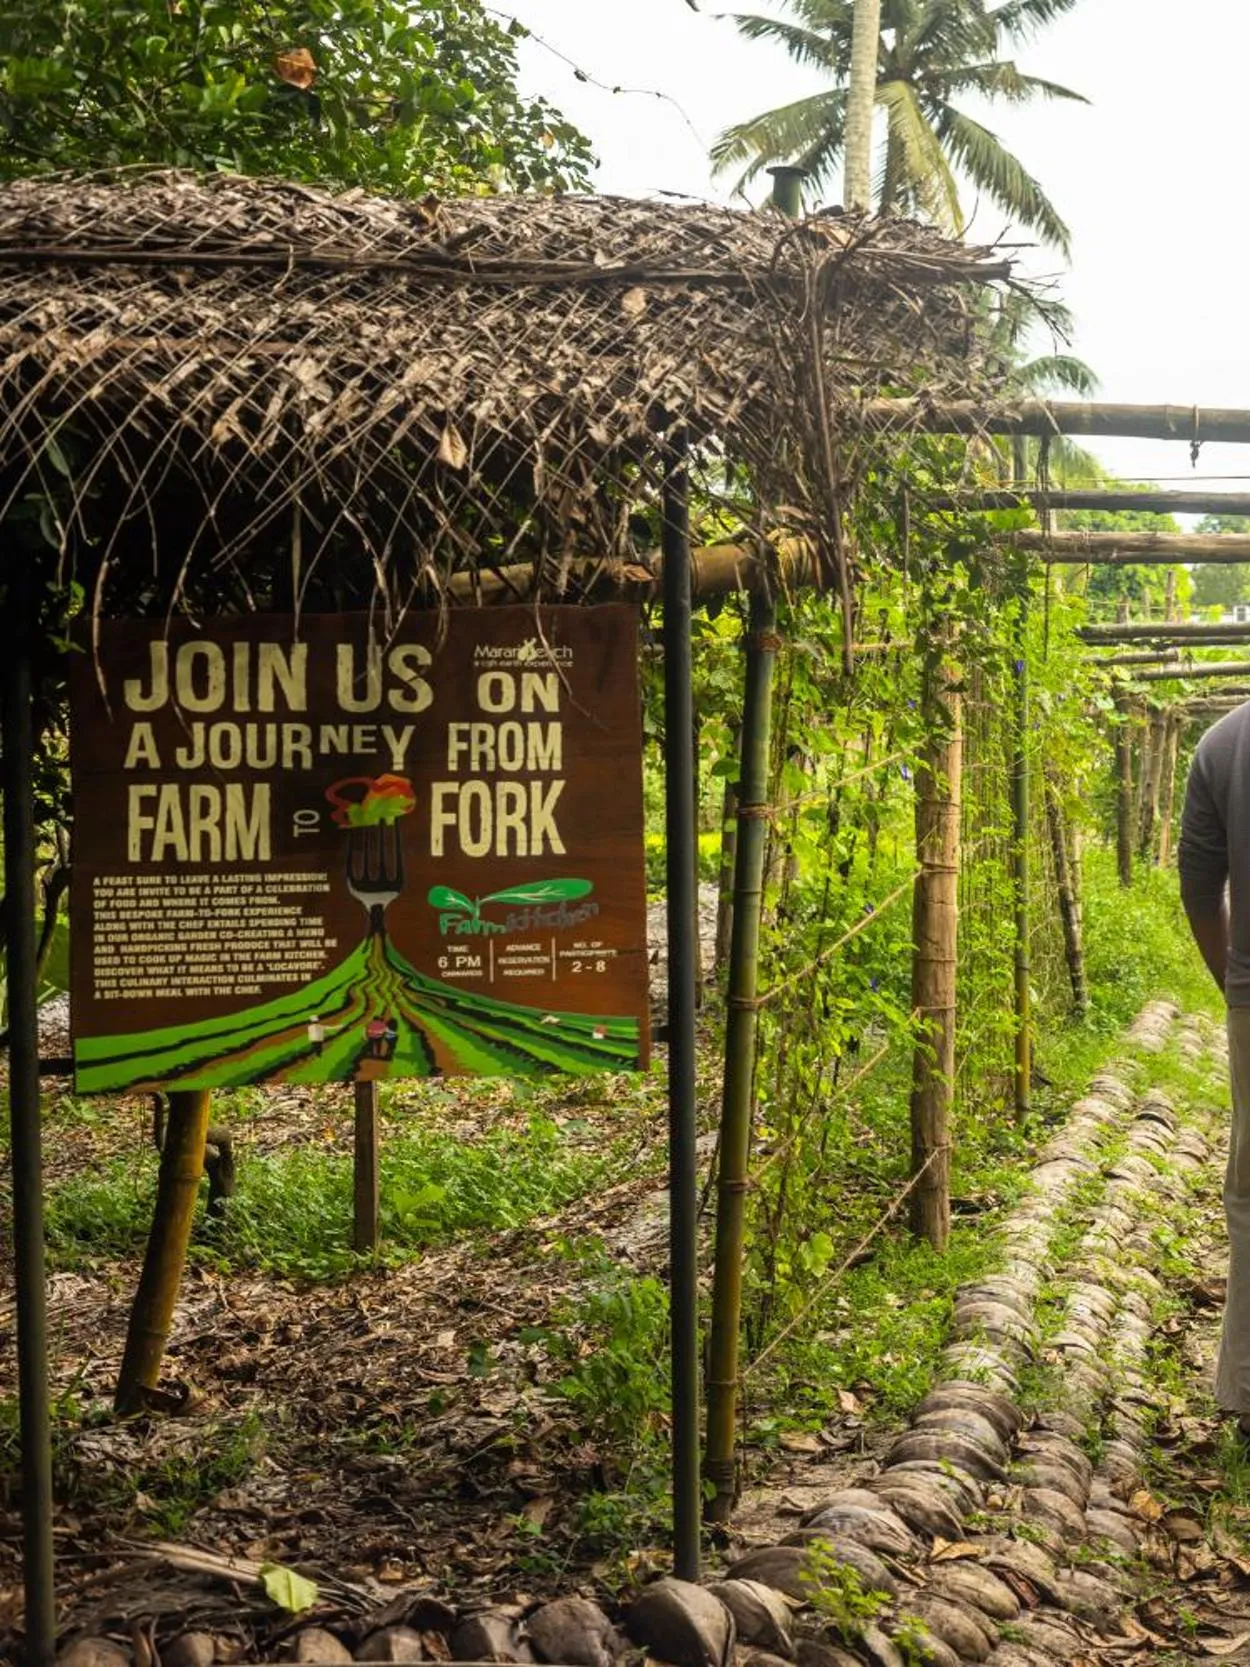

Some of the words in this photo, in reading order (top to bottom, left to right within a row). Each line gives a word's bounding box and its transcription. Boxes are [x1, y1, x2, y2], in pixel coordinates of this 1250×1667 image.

[124, 640, 308, 712] JOIN
[336, 644, 434, 712] US
[477, 671, 560, 712] ON
[124, 722, 160, 769] A
[176, 722, 416, 771] JOURNEY
[448, 721, 562, 772] FROM
[128, 782, 272, 862] FARM
[293, 809, 320, 838] TO
[430, 780, 566, 858] FORK
[93, 877, 100, 885] A
[103, 876, 133, 885] FEAST
[136, 876, 161, 884] SURE
[165, 876, 177, 884] TO
[181, 875, 210, 883] LEAVE
[222, 873, 261, 882] LASTING
[94, 889, 114, 897] YOU
[117, 888, 136, 896] ARE
[139, 888, 170, 896] INVITE
[214, 886, 238, 894] PART
[240, 885, 253, 893] OF
[265, 884, 330, 892] CELEBRATION
[94, 900, 106, 909] OF
[110, 900, 136, 908] FOOD
[162, 898, 197, 906] WHERE
[120, 910, 163, 919] BESPOKE
[243, 907, 302, 916] EXPERIENCE
[94, 922, 126, 931] ALONG
[207, 918, 246, 928] ENTAILS
[249, 918, 296, 926] SPENDING
[300, 917, 323, 925] TIME
[131, 933, 175, 941] ORGANIC
[178, 931, 216, 940] GARDEN
[220, 929, 284, 938] CO-CREATING
[297, 928, 324, 936] MENU
[94, 945, 114, 953] AND
[120, 944, 187, 953] HANDPICKING
[190, 942, 221, 950] FRESH
[225, 941, 270, 949] PRODUCE
[325, 939, 337, 947] BE
[506, 944, 542, 952] ADVANCE
[94, 956, 120, 965] USED
[185, 953, 216, 962] MAGIC
[220, 953, 230, 961] IN
[254, 952, 281, 960] FARM
[438, 956, 448, 969] 6
[456, 956, 481, 968] PM
[498, 956, 550, 964] RESERVATION
[94, 967, 144, 976] DISCOVER
[190, 964, 224, 973] MEANS
[572, 961, 582, 972] 2
[596, 960, 606, 972] 8
[120, 978, 168, 986] CULINARY
[171, 976, 234, 985] INTERACTION
[238, 973, 299, 983] CULMINATES
[104, 989, 153, 998] SIT-DOWN
[156, 988, 182, 997] MEAL
[185, 987, 210, 996] WITH
